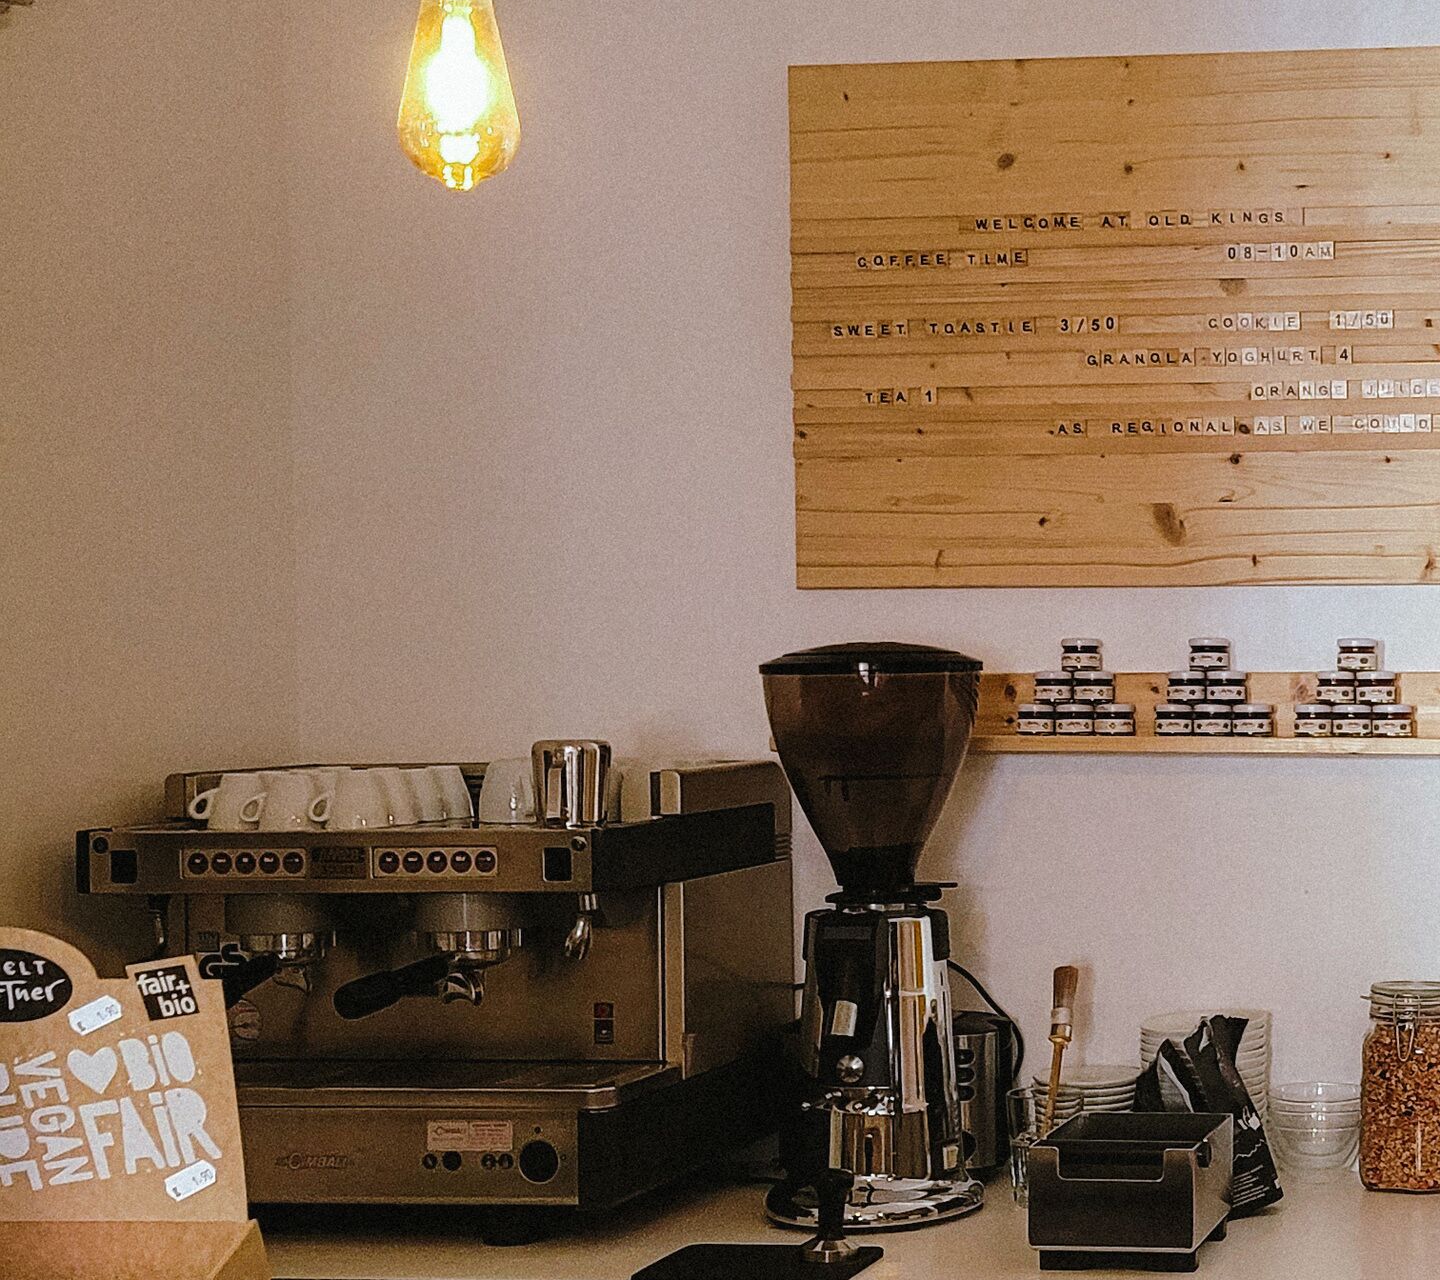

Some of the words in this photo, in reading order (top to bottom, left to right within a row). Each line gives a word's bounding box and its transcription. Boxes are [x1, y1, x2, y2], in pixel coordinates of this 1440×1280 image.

[975, 216, 1081, 231] WELCOME
[1101, 215, 1129, 228] AT
[1149, 214, 1192, 227] OLD
[1211, 211, 1285, 225] KINGS
[857, 254, 945, 269] COFFEE
[967, 253, 1027, 266] TIME
[832, 323, 907, 337] SWEET
[929, 322, 1034, 334] TOASTIE
[1059, 316, 1116, 333] 3/50
[1208, 316, 1299, 329] COOKIE
[1333, 312, 1390, 327] 1/50
[1086, 351, 1192, 367] GRANOLA
[1211, 349, 1319, 364] YOGHURT
[1338, 348, 1349, 362] 4
[865, 390, 907, 404] TEA
[924, 389, 933, 403] 1
[1254, 381, 1346, 398] ORANGE
[1058, 422, 1083, 435] AS
[1111, 419, 1231, 435] REGIONAL
[1256, 421, 1283, 434] AS
[1301, 420, 1329, 432] WE
[1354, 417, 1431, 431] COULD
[157, 993, 196, 1017] bio
[14, 1051, 94, 1186] VEGAN
